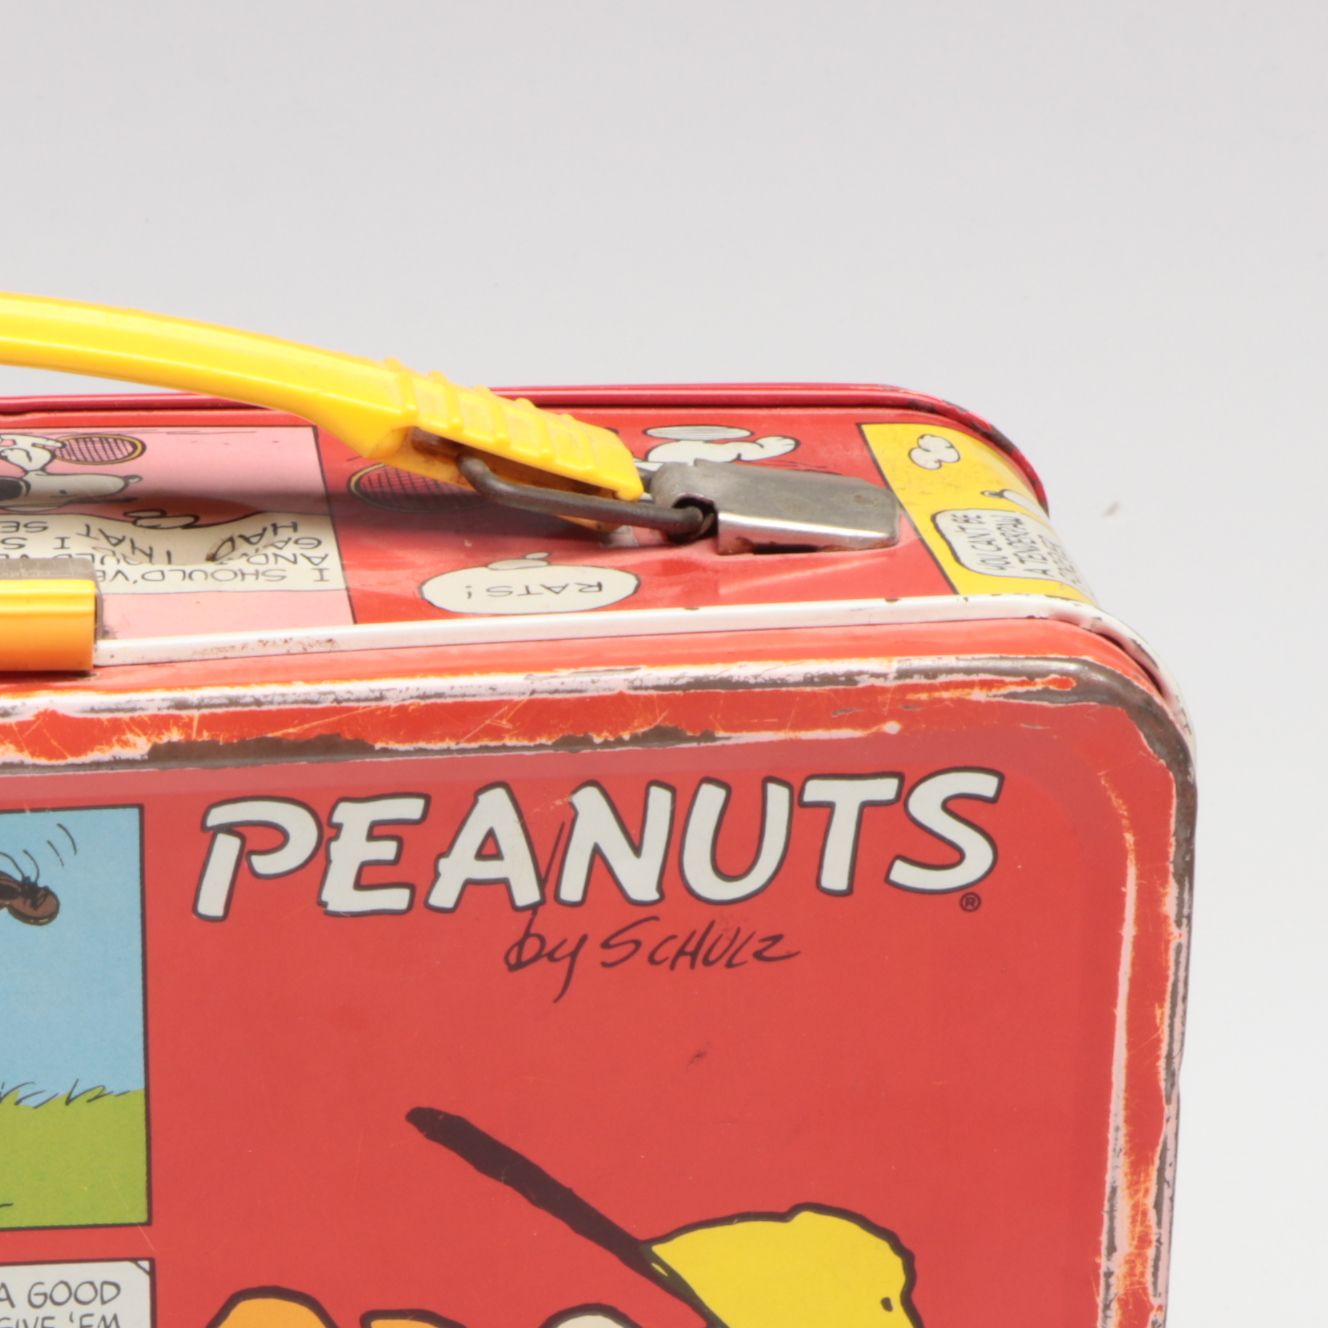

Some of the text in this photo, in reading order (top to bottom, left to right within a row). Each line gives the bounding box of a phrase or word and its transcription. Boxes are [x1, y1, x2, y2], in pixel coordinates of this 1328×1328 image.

[53, 536, 71, 549] I
[313, 567, 330, 582] I
[465, 581, 603, 599] RATS!
[26, 1279, 122, 1310] GOOD
